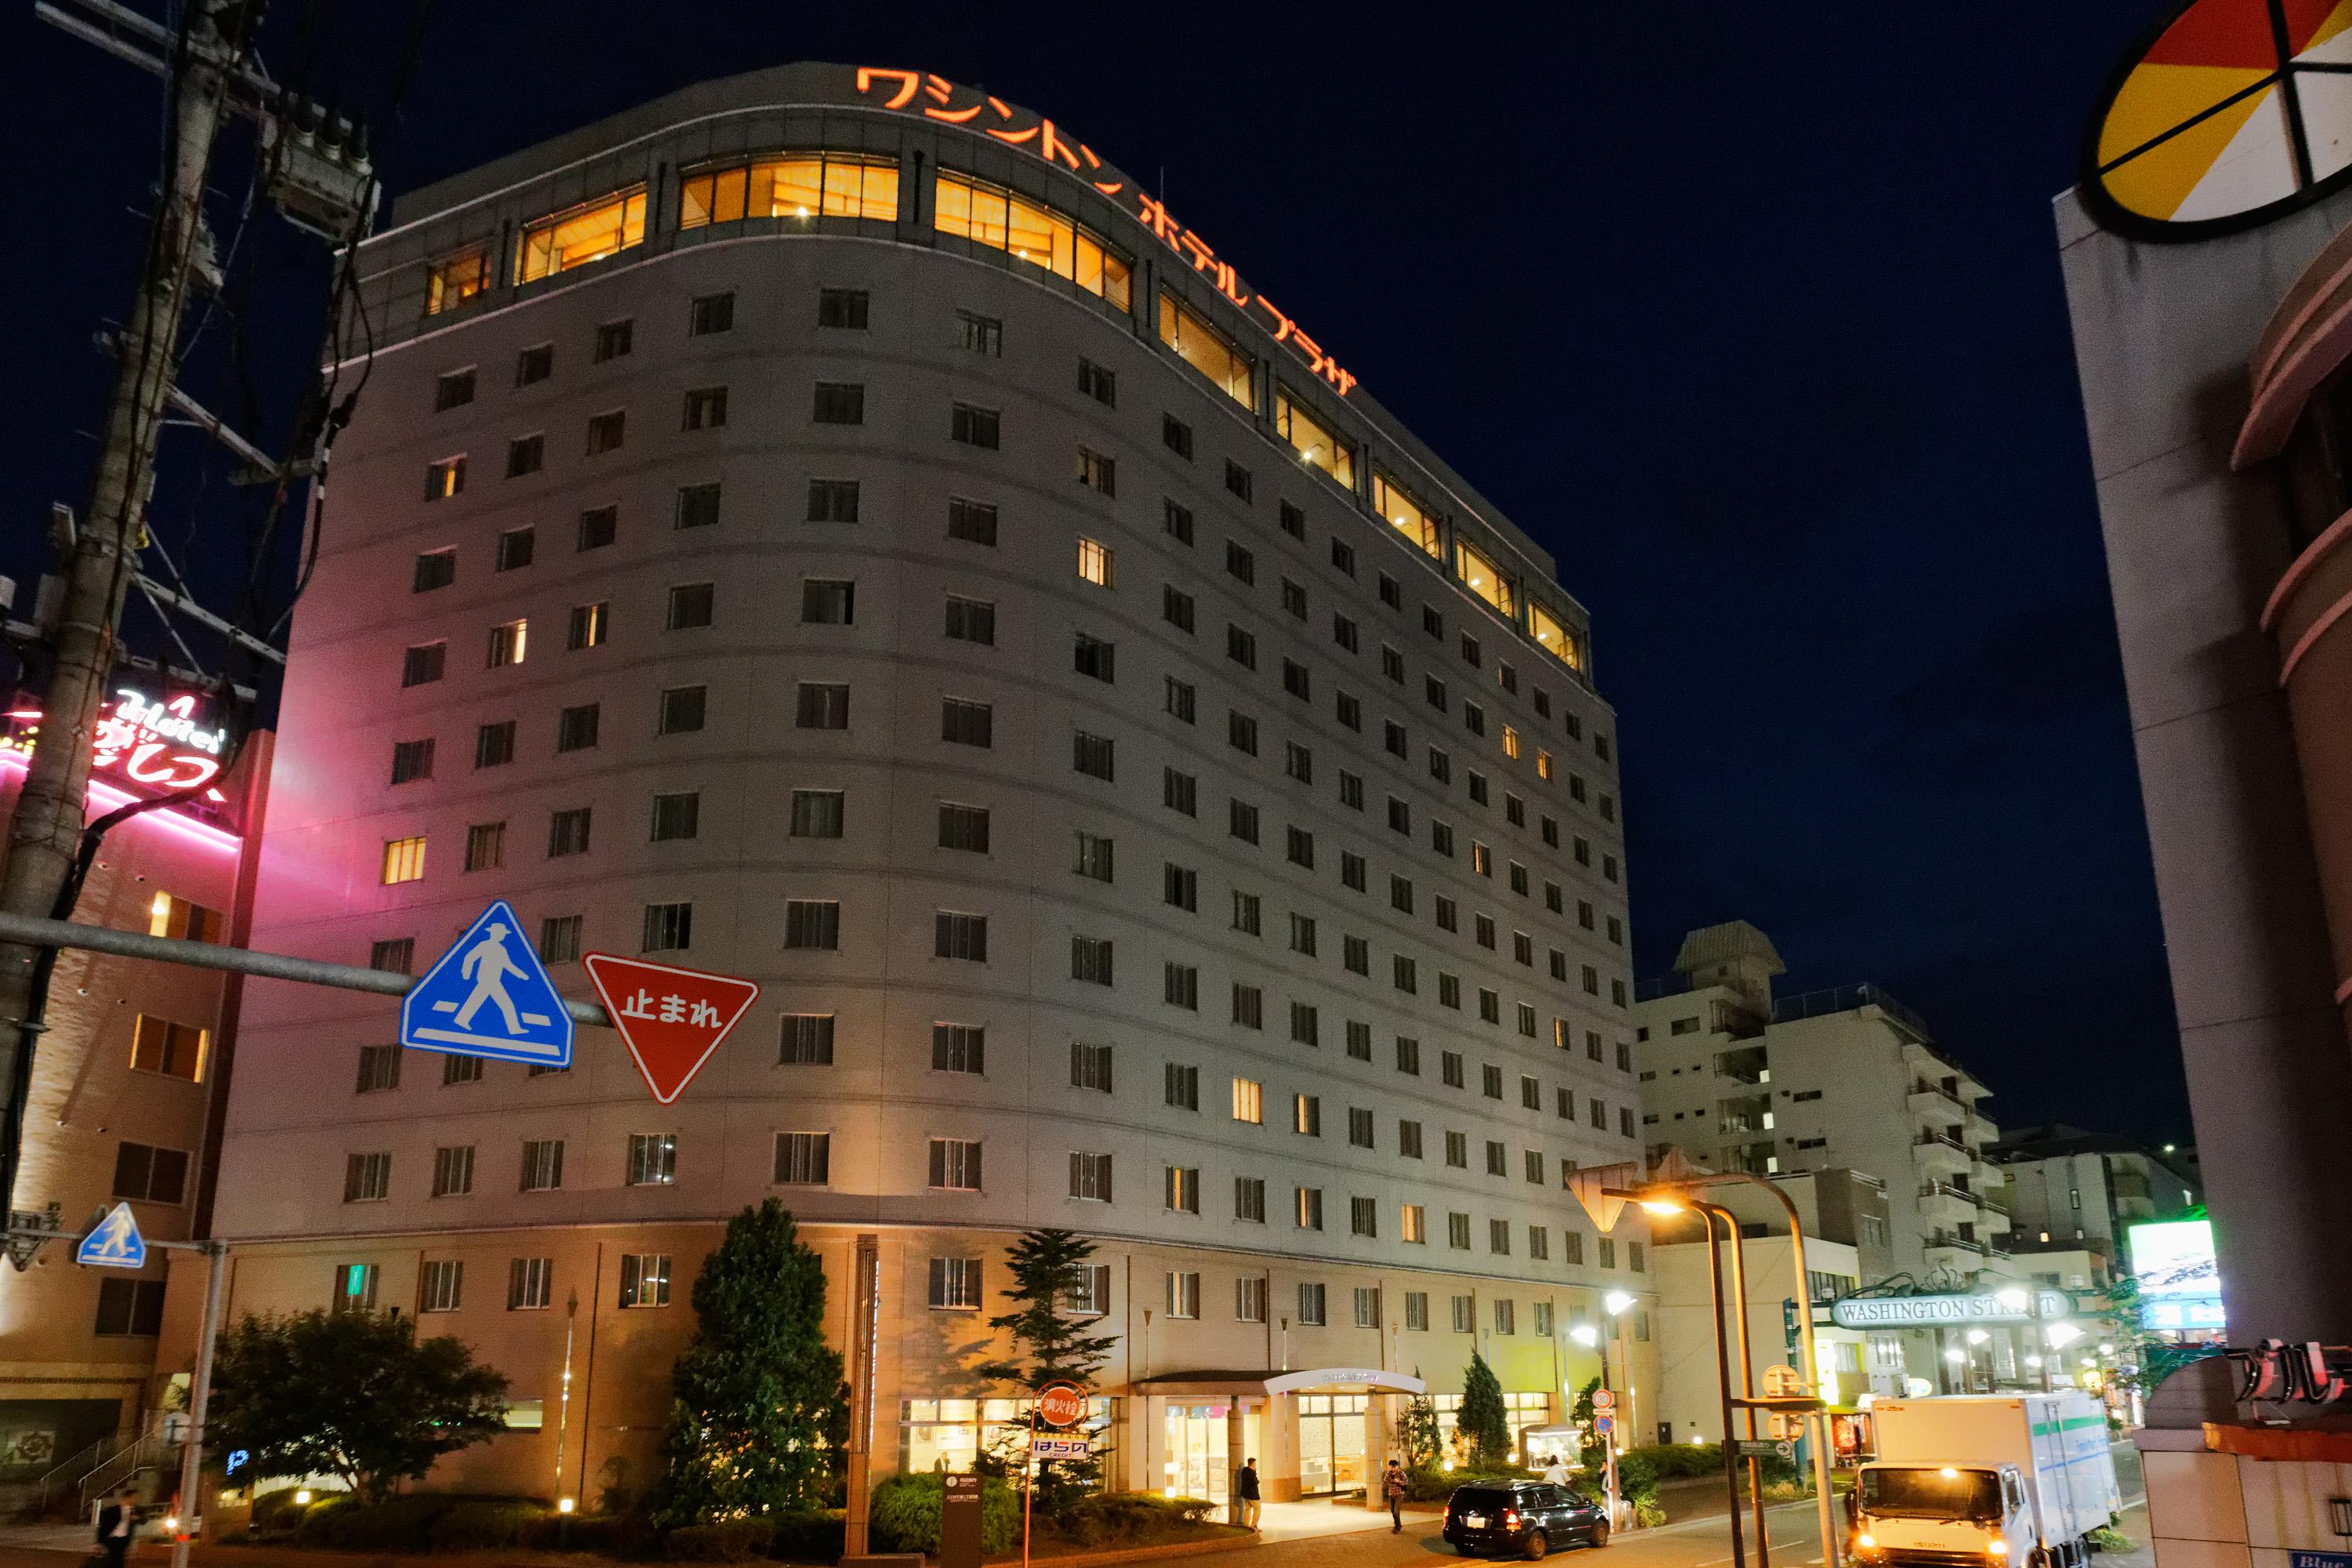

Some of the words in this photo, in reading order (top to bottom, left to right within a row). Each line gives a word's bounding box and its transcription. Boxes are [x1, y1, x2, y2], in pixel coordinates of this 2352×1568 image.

[856, 67, 1123, 194] ワシントン
[1138, 193, 1249, 307] ホテル
[1256, 294, 1357, 396] プラザ
[619, 988, 723, 1029] 止まれ
[1842, 1300, 1965, 1321] WASHINGTON
[1044, 1398, 1078, 1416] 消火栓
[1034, 1440, 1087, 1454] はらの
[226, 1450, 249, 1475] P
[2299, 1555, 2344, 1568] Blue
